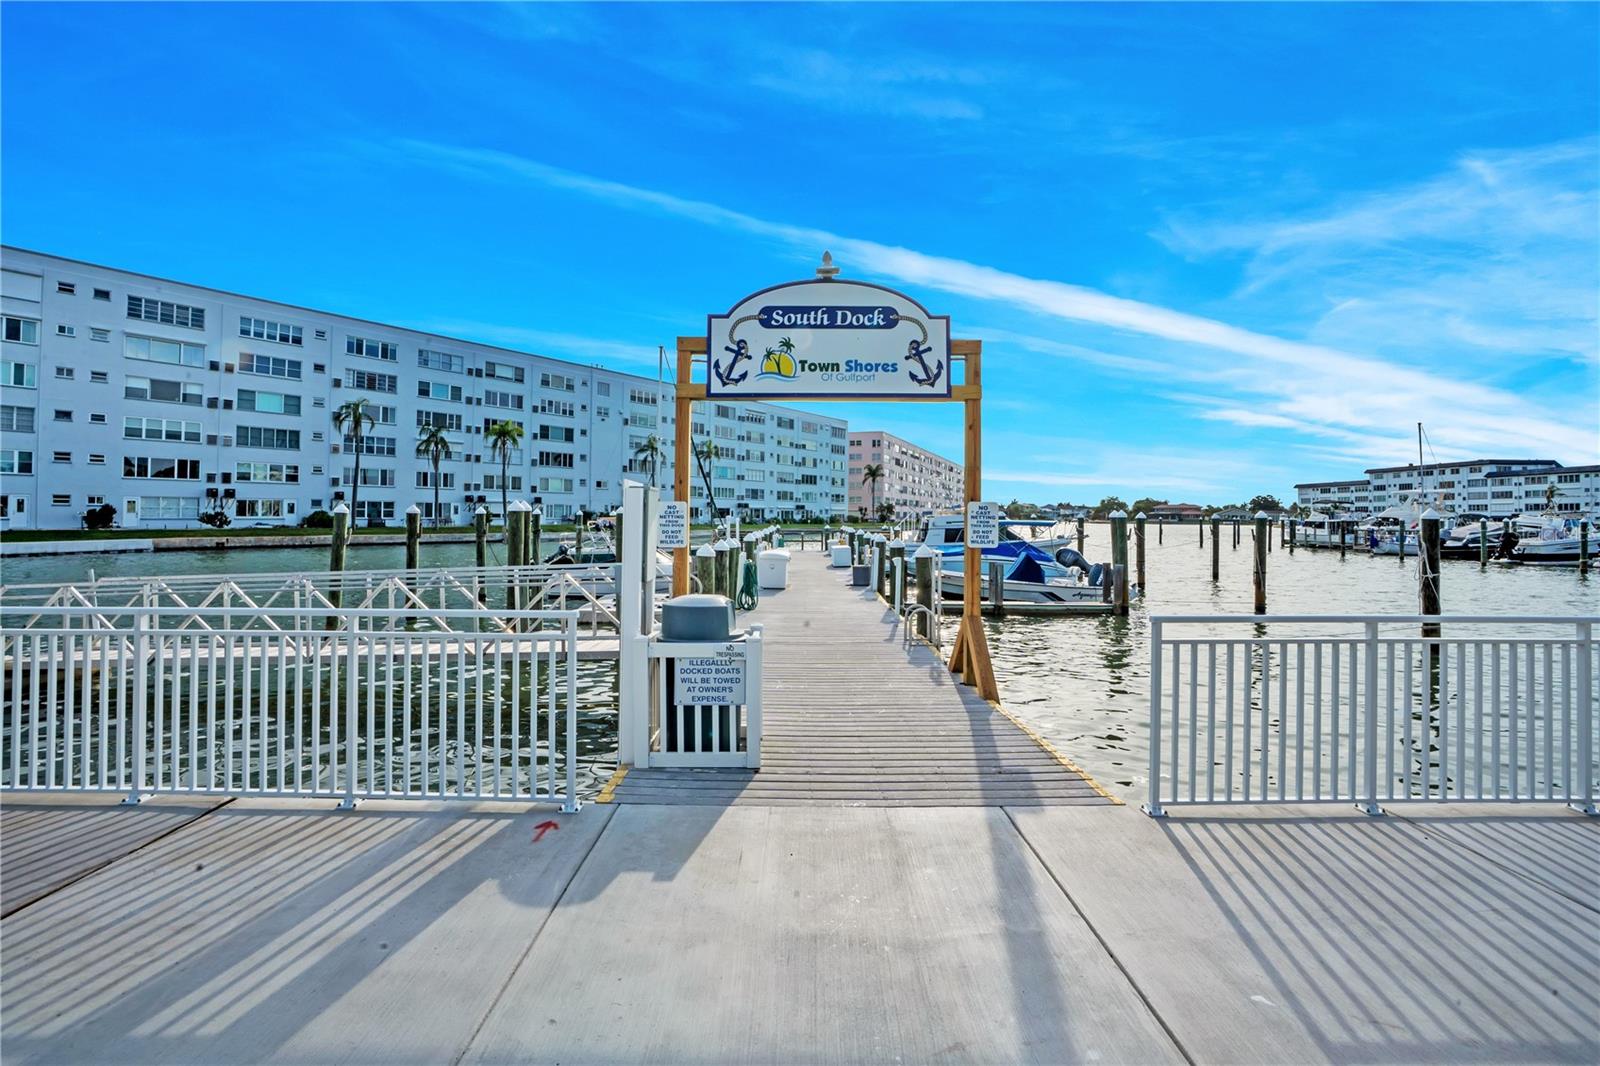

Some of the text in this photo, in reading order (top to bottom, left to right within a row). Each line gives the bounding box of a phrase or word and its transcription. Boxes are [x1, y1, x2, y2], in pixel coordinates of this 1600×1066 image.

[771, 307, 887, 326] South Dock
[799, 359, 898, 373] Town Shores
[821, 373, 876, 383] Of Gulfport
